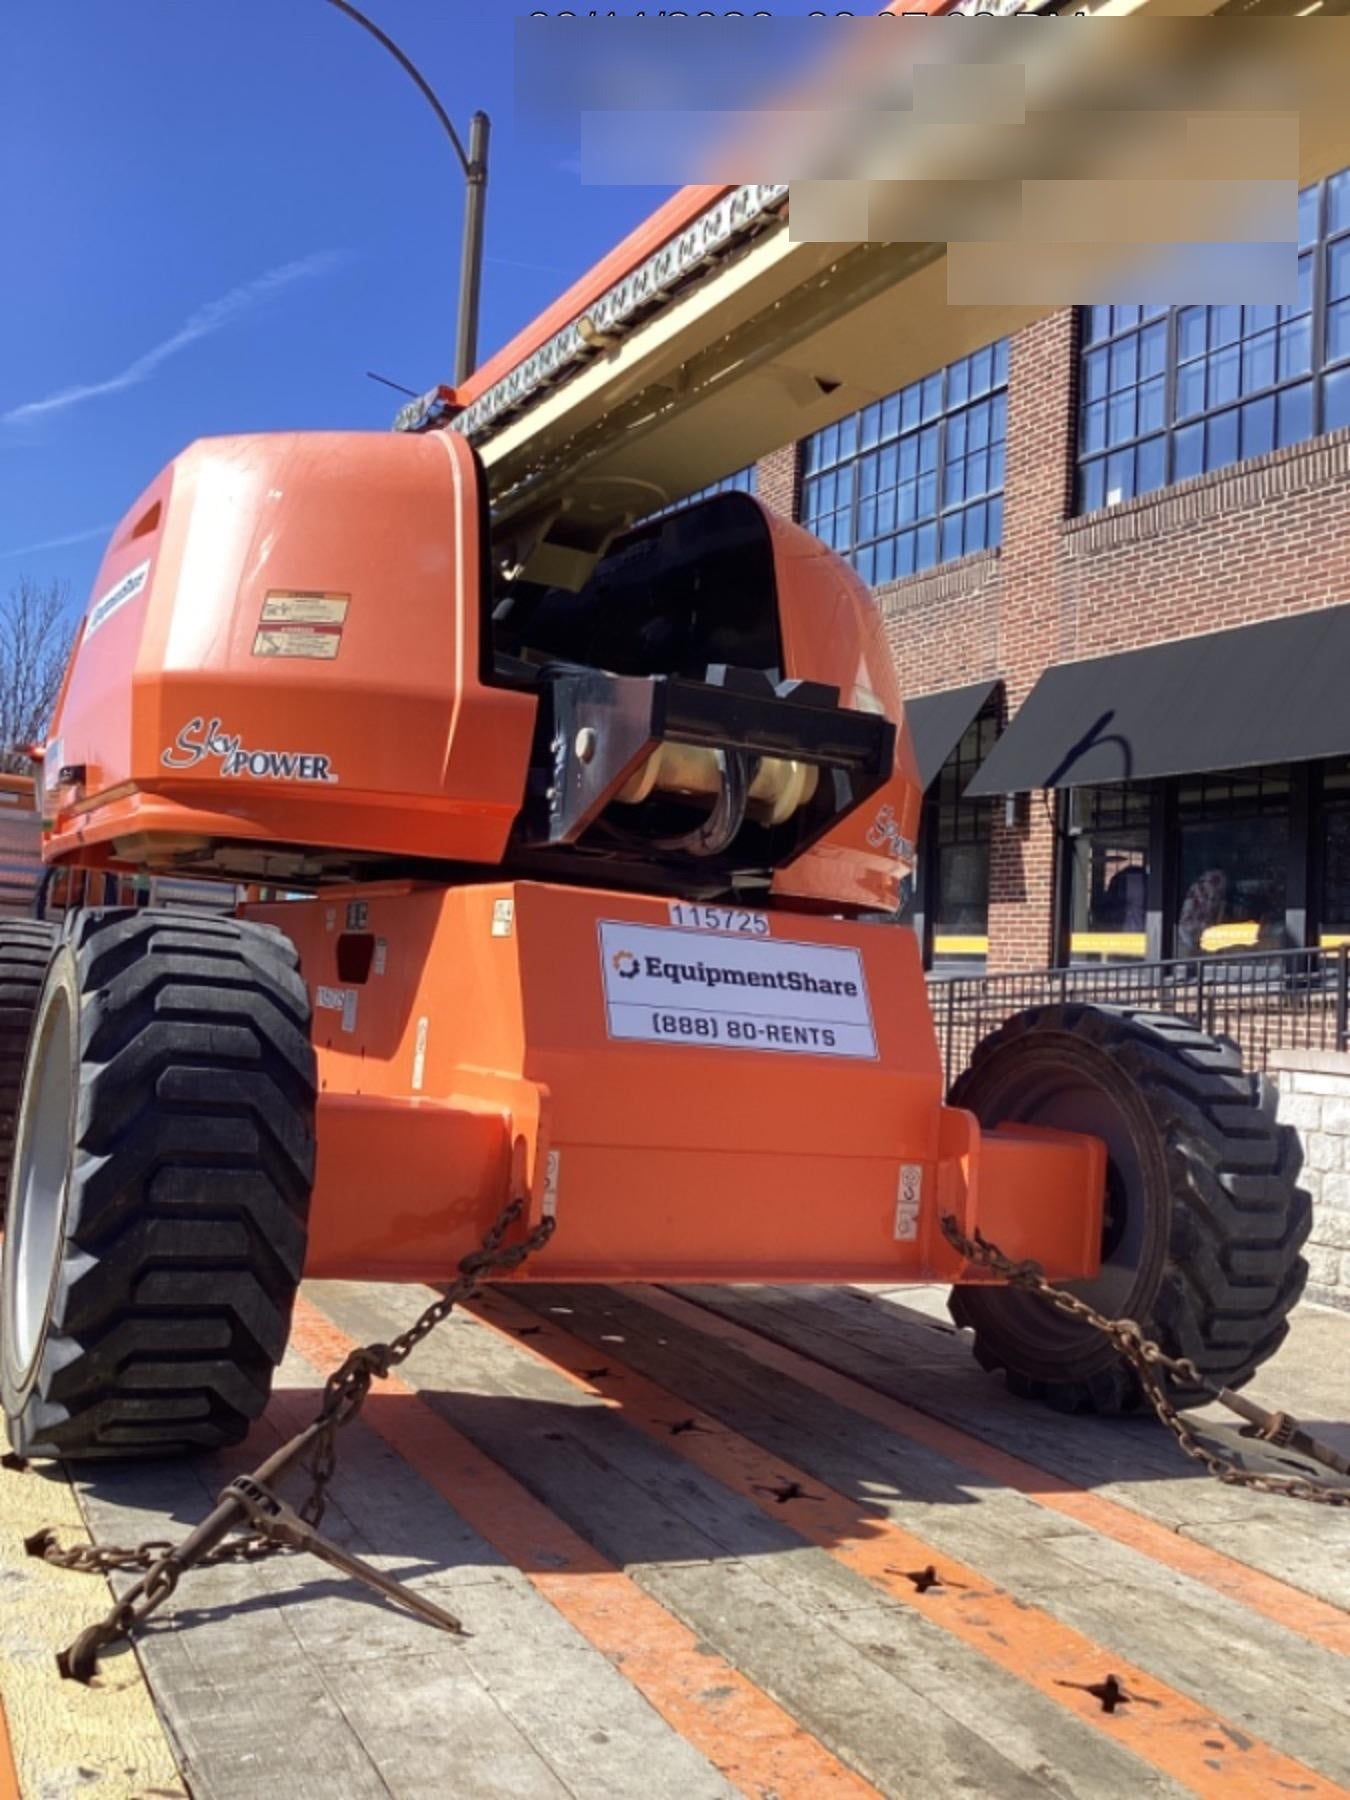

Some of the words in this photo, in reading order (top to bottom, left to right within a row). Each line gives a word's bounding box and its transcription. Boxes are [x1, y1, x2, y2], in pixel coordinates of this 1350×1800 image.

[672, 904, 769, 935] 115725
[644, 956, 858, 997] EquipmentShare
[653, 1012, 718, 1039] (888)
[727, 1021, 836, 1047] 80-RENTS
